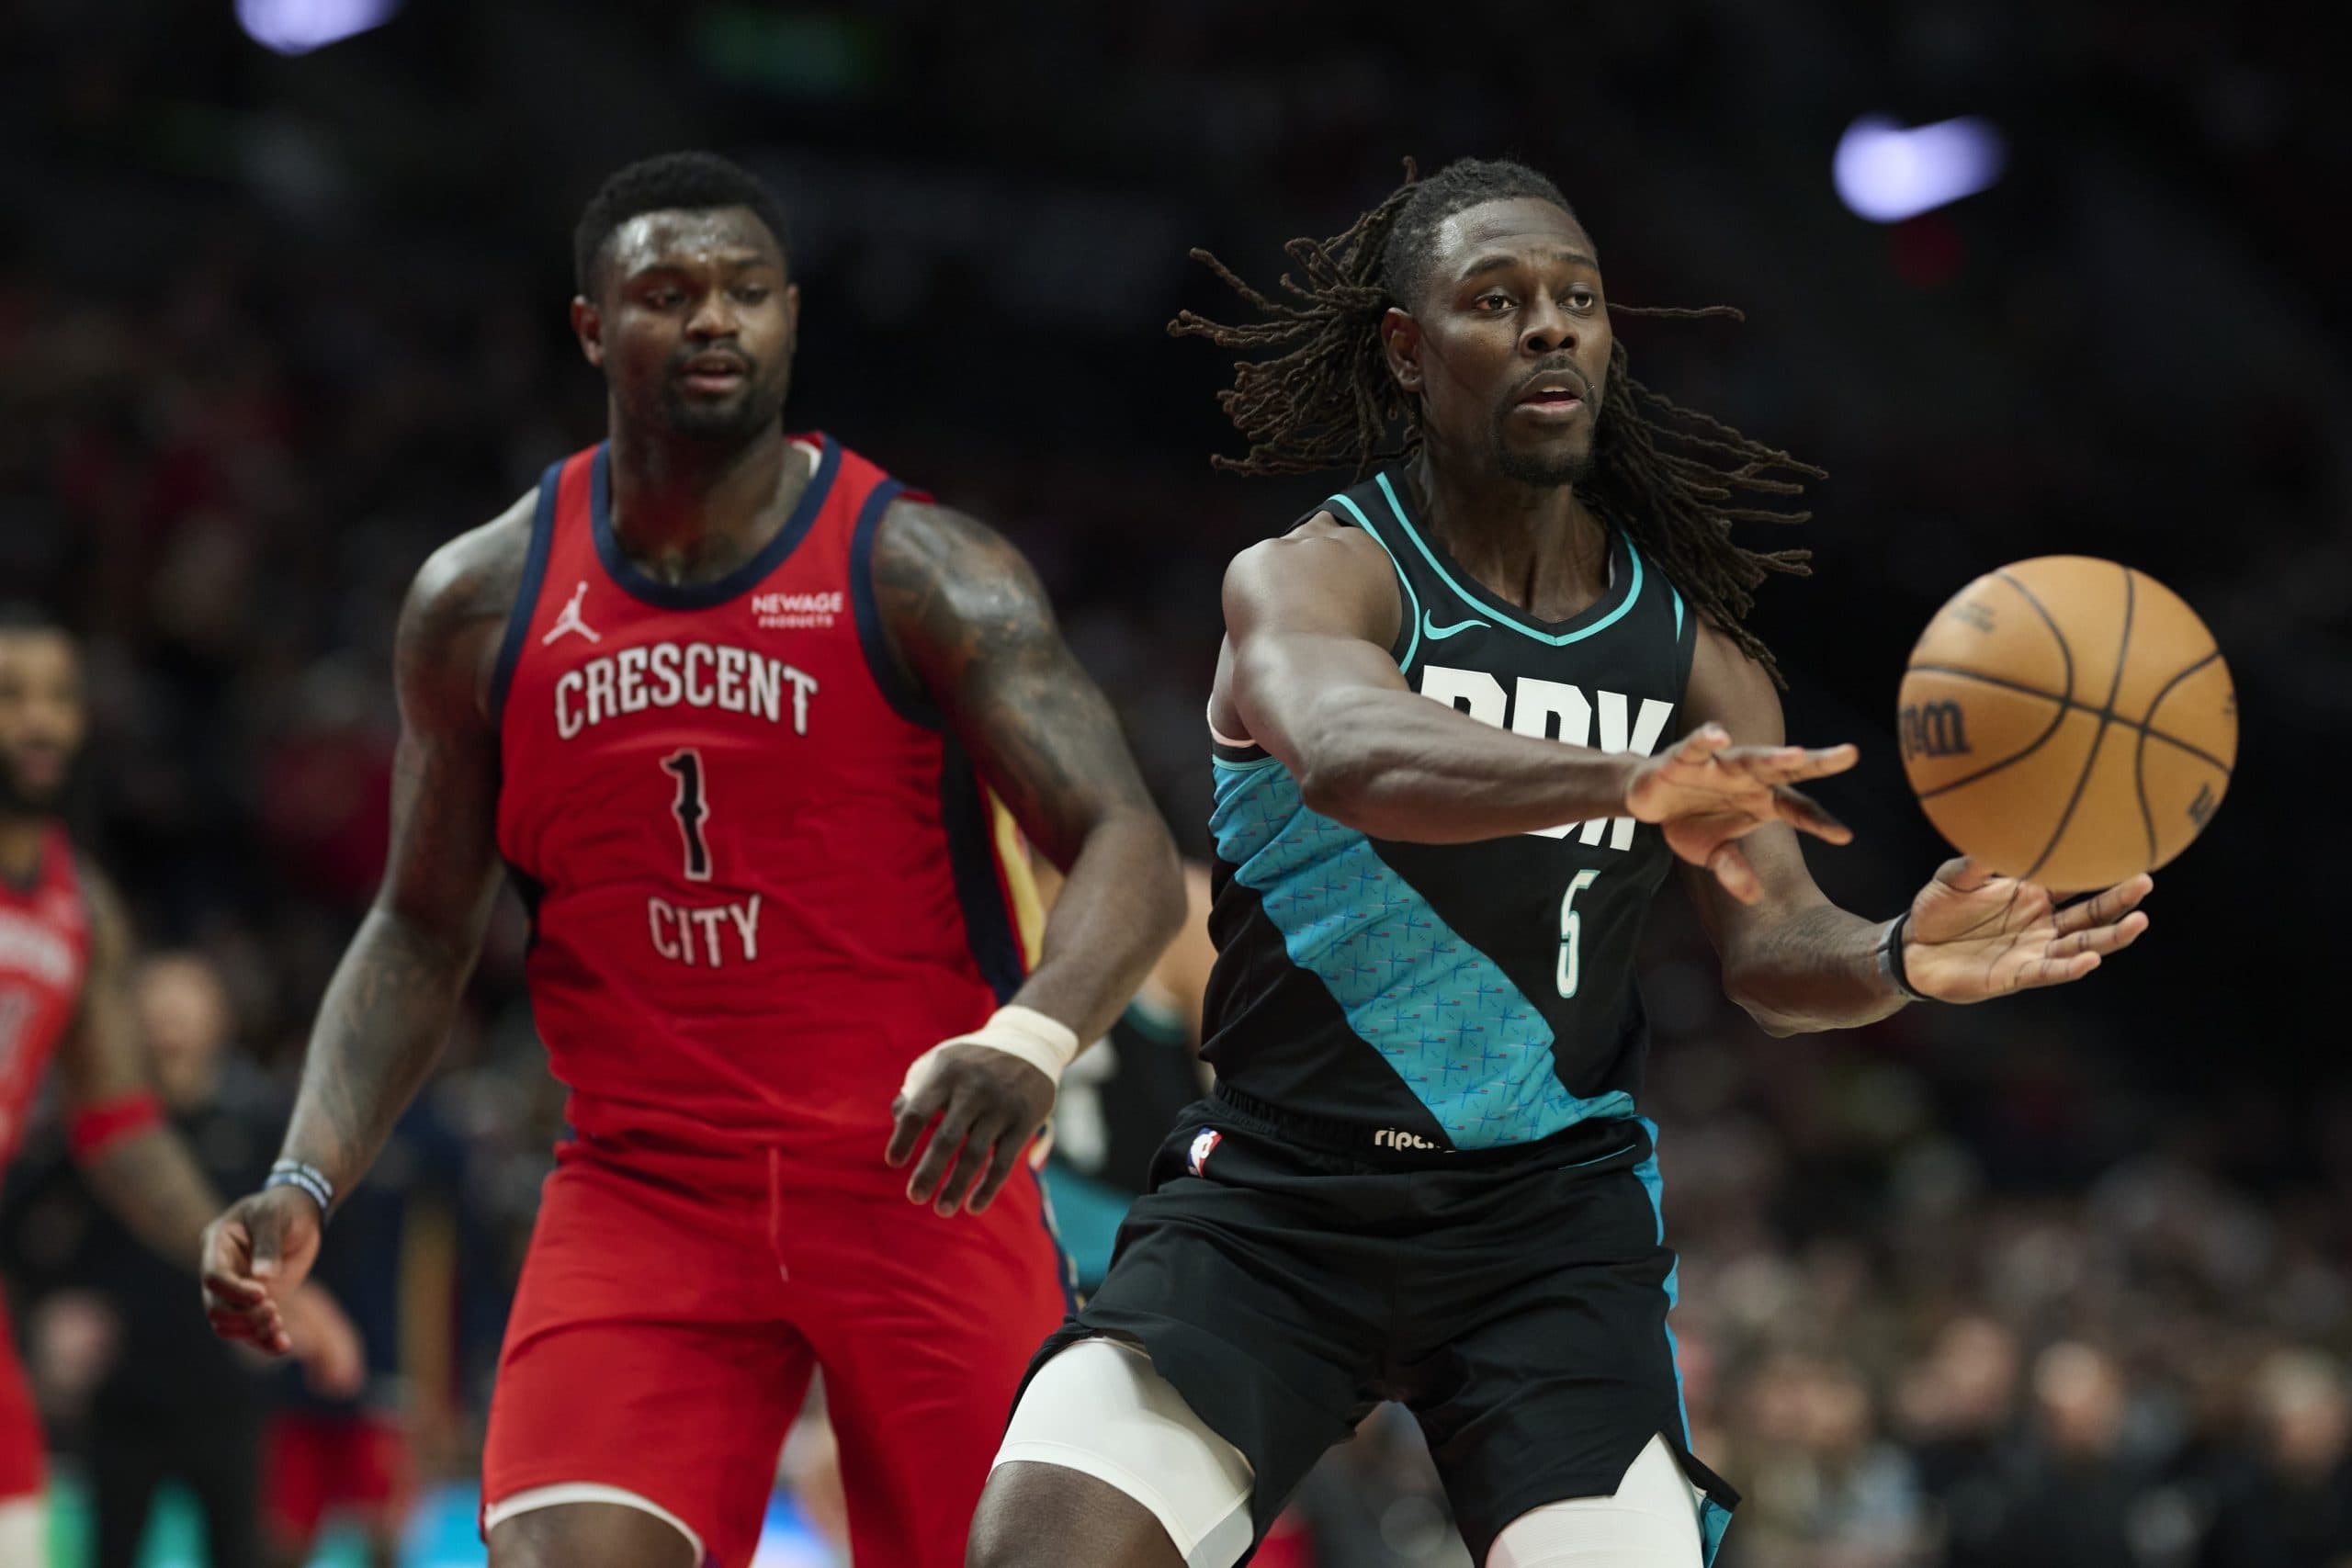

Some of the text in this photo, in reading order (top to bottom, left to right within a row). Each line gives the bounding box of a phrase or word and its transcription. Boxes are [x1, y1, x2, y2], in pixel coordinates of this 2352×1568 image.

[751, 592, 843, 615] NEWAGE
[555, 642, 819, 740] CRESCENT
[659, 748, 712, 882] 1
[648, 893, 763, 968] CITY
[1556, 869, 1600, 998] 5
